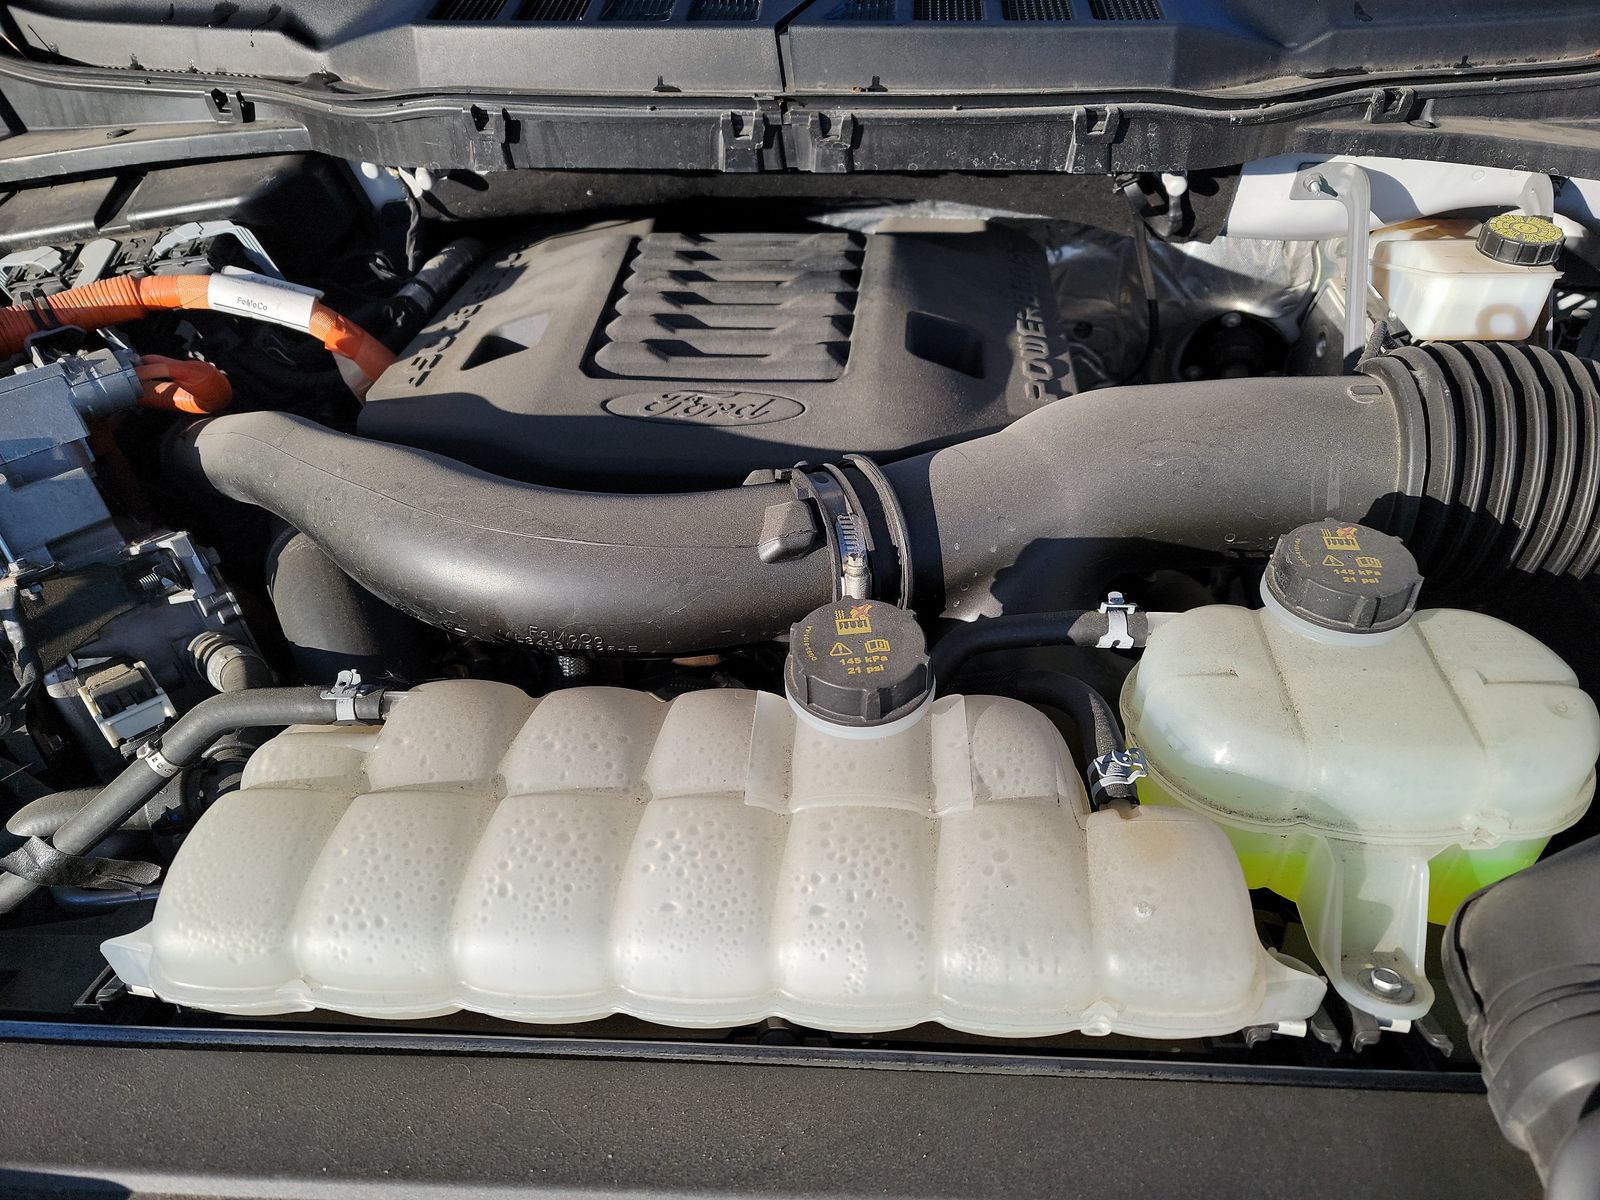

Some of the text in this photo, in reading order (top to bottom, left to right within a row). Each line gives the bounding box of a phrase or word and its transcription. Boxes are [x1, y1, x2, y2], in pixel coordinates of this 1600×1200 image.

[236, 296, 268, 311] FoMoCo
[638, 389, 777, 420] Ford
[1333, 568, 1382, 577] 145 kPa
[1343, 576, 1380, 585] 21 psi
[528, 624, 603, 645] FoMoCo
[839, 654, 889, 666] 145 kPa
[847, 664, 885, 676] 21 psi
